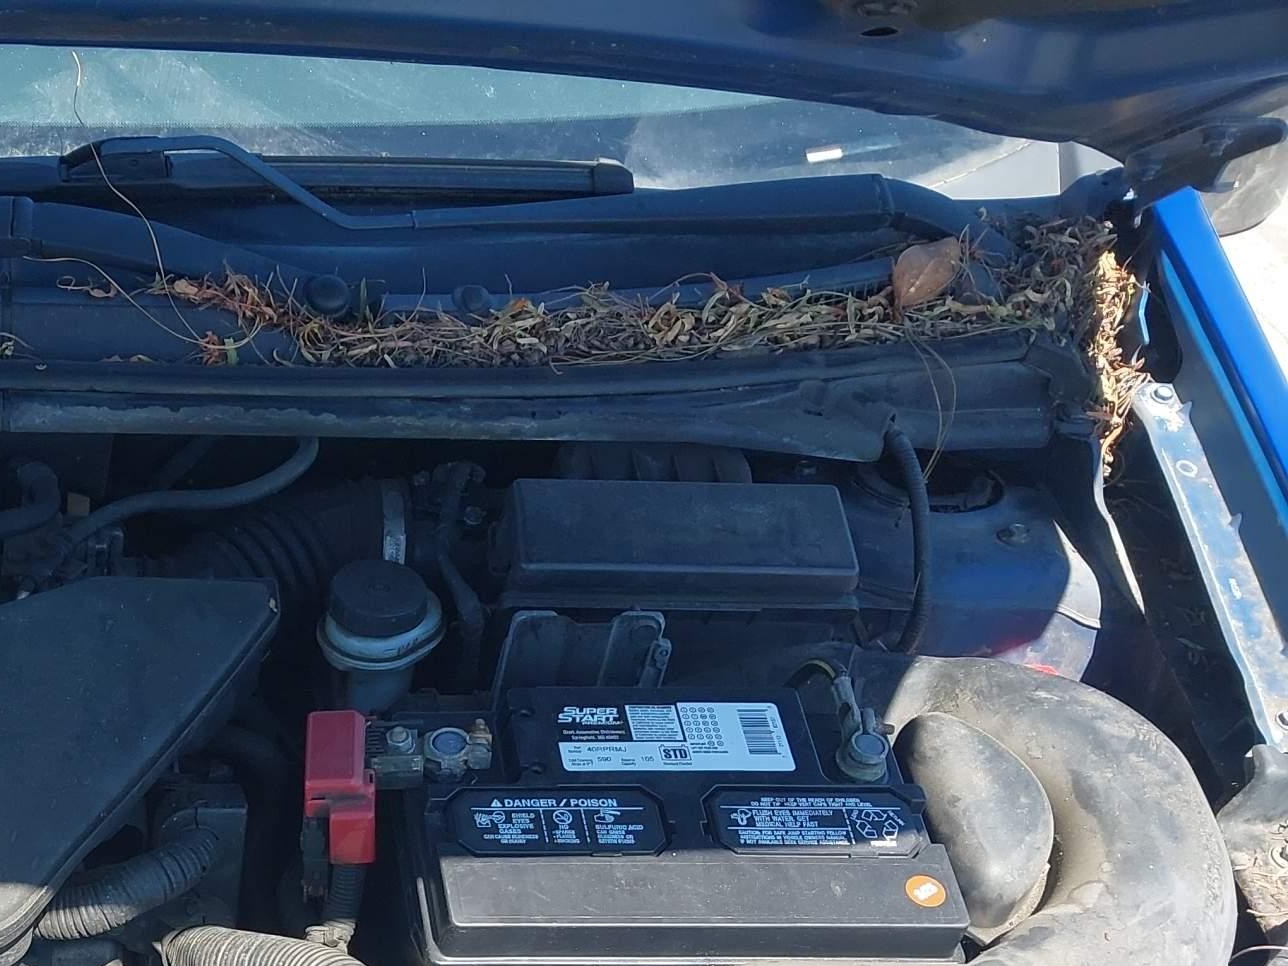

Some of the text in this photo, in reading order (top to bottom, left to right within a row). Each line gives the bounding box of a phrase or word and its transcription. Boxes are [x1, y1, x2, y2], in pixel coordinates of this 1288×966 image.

[563, 706, 619, 716] SUPER
[557, 713, 621, 724] START
[662, 748, 688, 760] STD
[503, 798, 557, 808] DANGER
[569, 798, 618, 808] POISON
